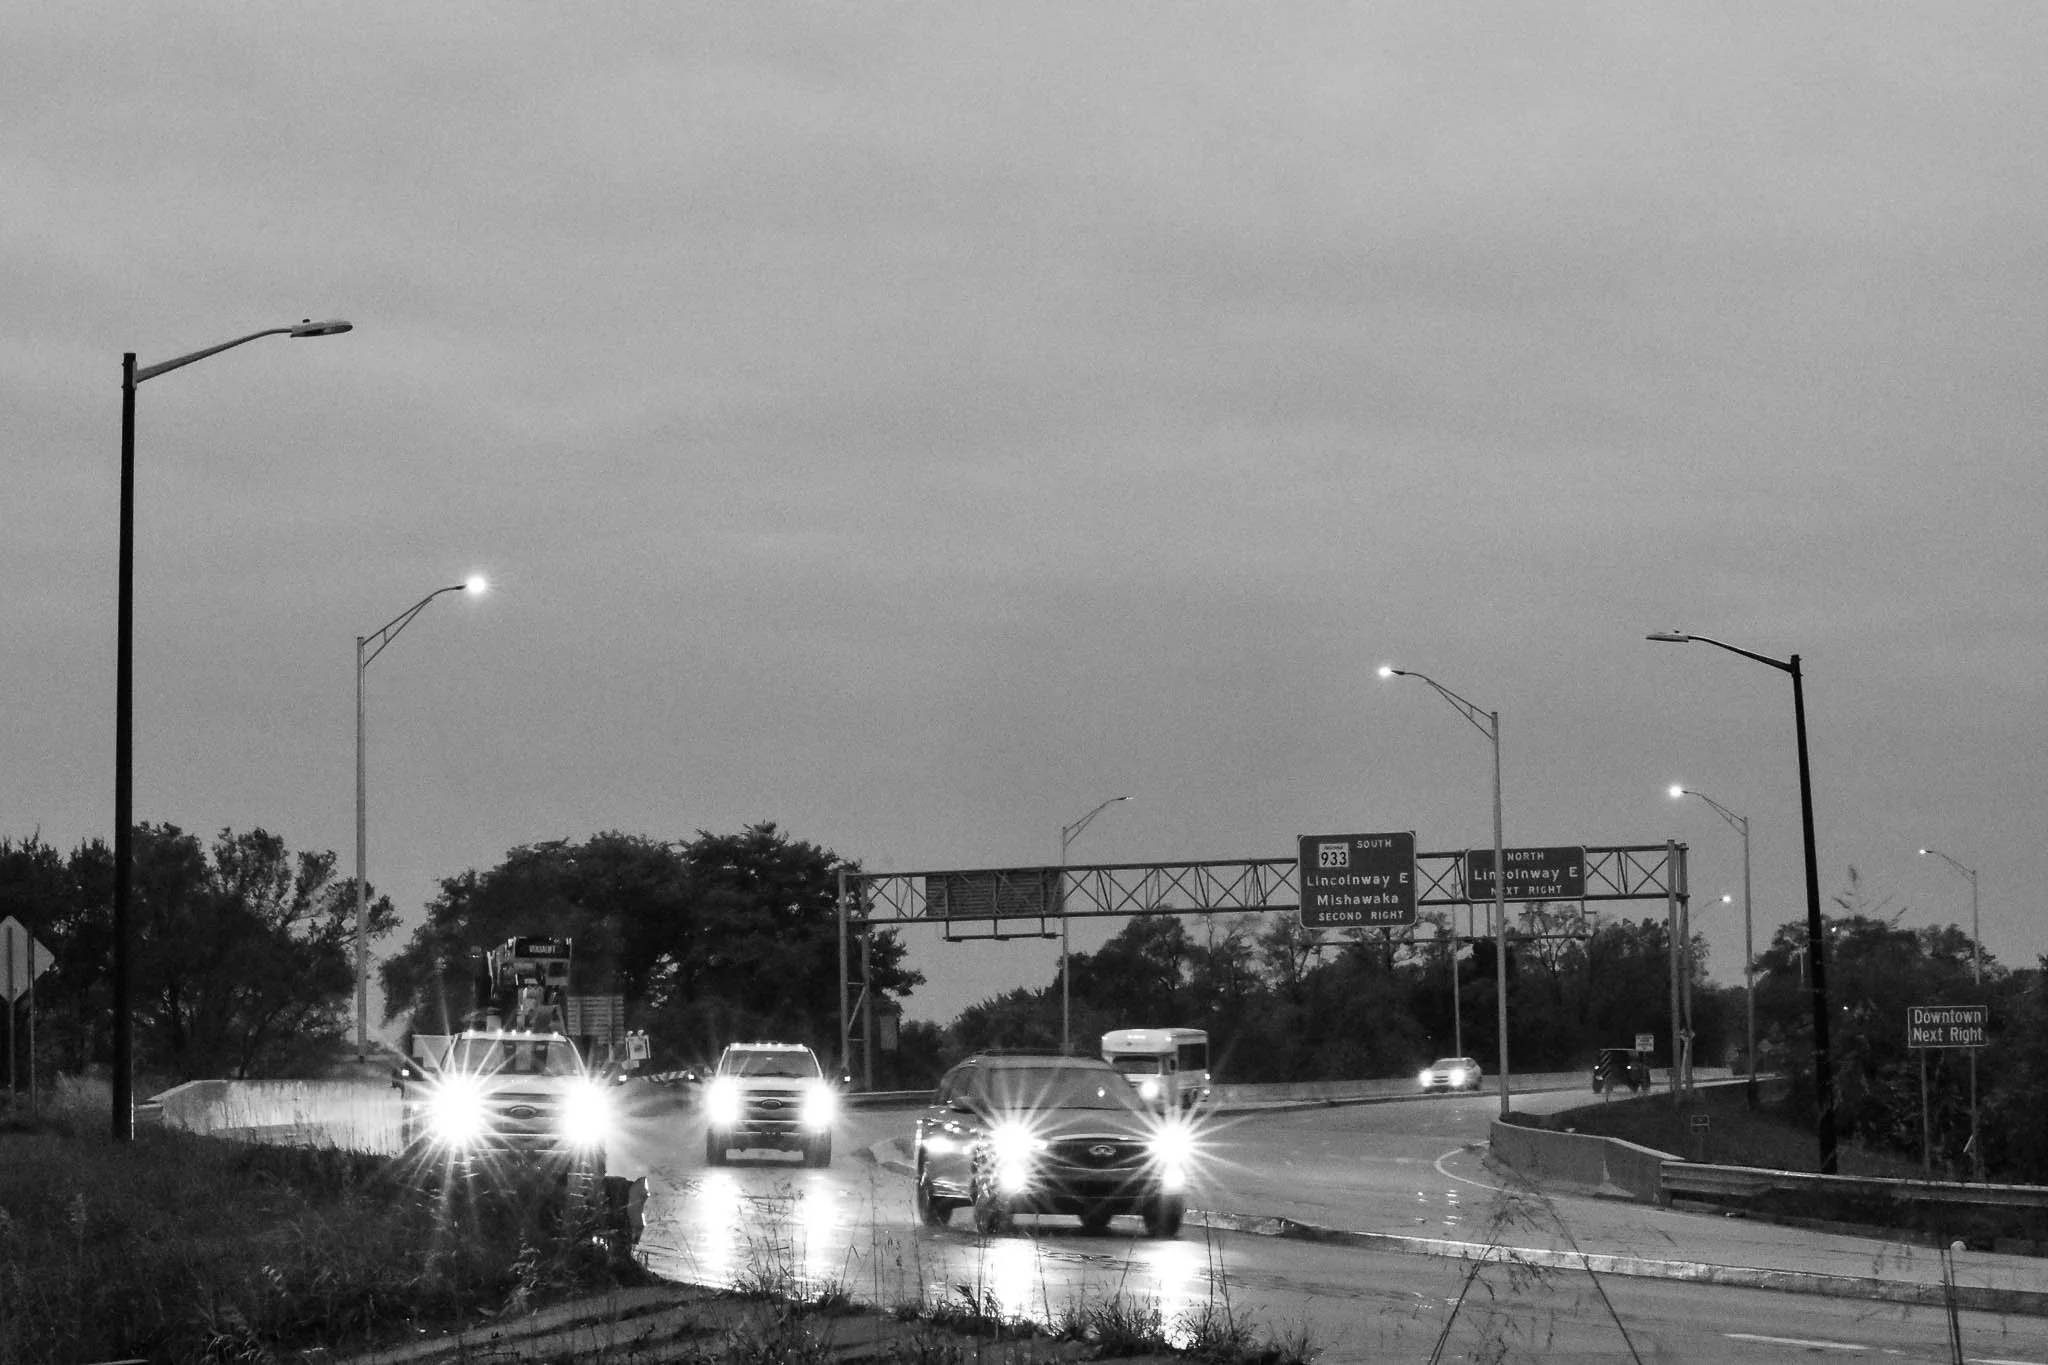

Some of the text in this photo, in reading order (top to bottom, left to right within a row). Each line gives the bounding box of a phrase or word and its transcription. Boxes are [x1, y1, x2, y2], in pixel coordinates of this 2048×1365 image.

[1356, 839, 1392, 849] SOUTH
[1320, 851, 1347, 866] 933
[1507, 852, 1544, 861] NORTH
[1306, 872, 1409, 888] Lincolnway E
[1474, 867, 1578, 882] Linolnway E
[1491, 885, 1562, 895] NXT RIGHT
[1317, 893, 1399, 906] Mishawaka
[1318, 910, 1404, 922] SECOND RIGHT
[1914, 1010, 1982, 1024] Downtown
[1913, 1027, 1983, 1044] Next Right
